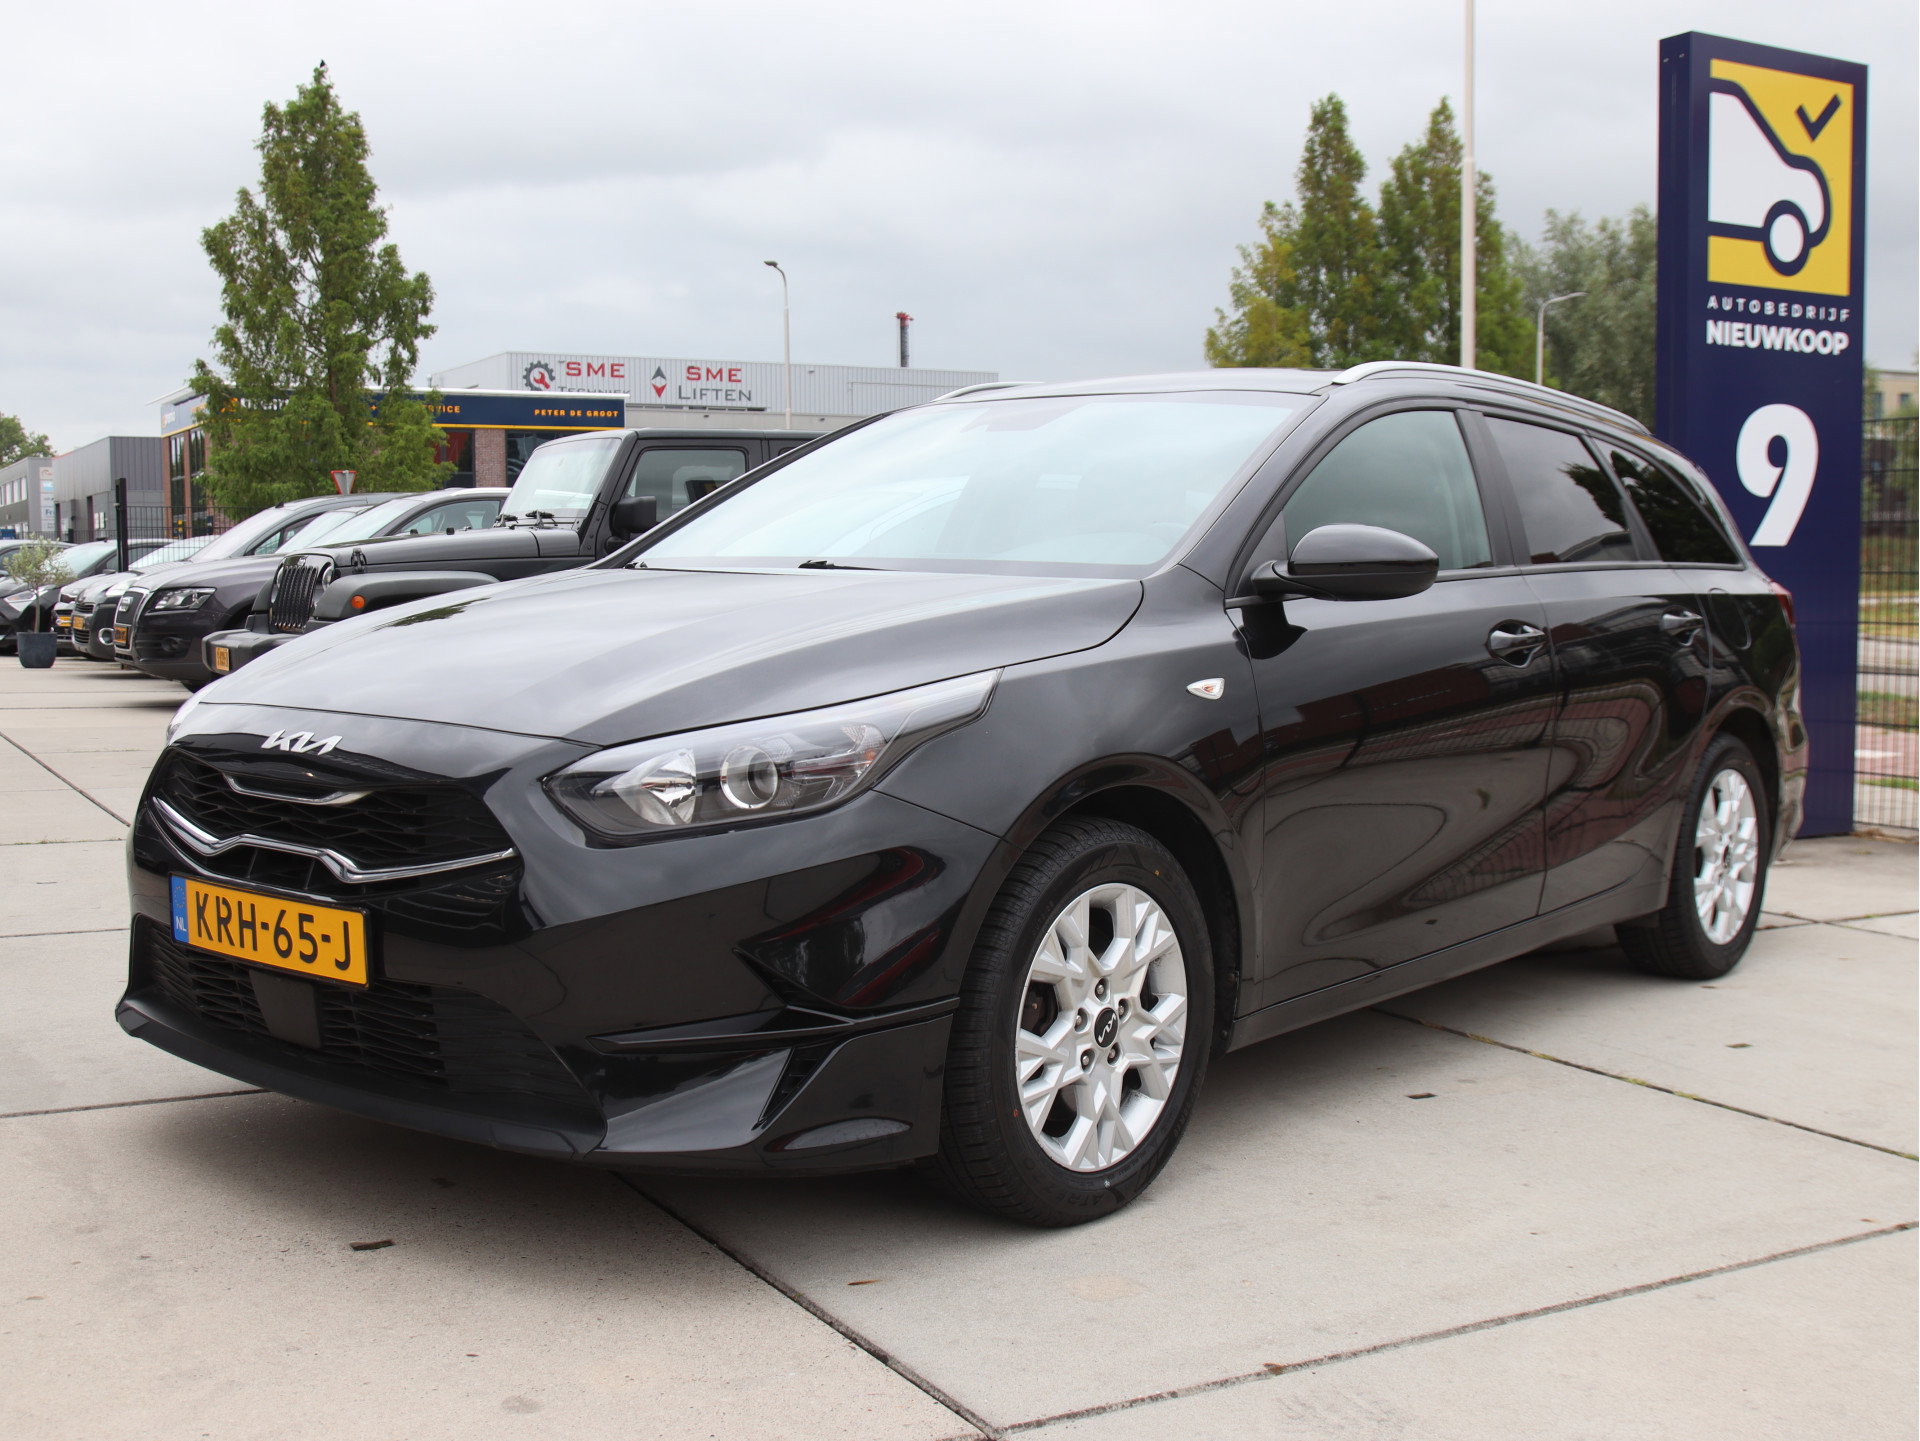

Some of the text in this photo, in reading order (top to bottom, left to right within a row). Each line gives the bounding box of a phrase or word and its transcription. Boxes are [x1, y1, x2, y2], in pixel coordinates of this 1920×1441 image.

[1707, 295, 1850, 322] AUTOBEDRIJF
[1706, 319, 1850, 356] NIEUWKOOP
[566, 361, 625, 378] SME
[686, 365, 742, 383] SME
[1736, 403, 1819, 547] 9
[261, 729, 343, 755] KIA
[175, 917, 187, 932] NL
[195, 891, 351, 971] KRH-65-J
